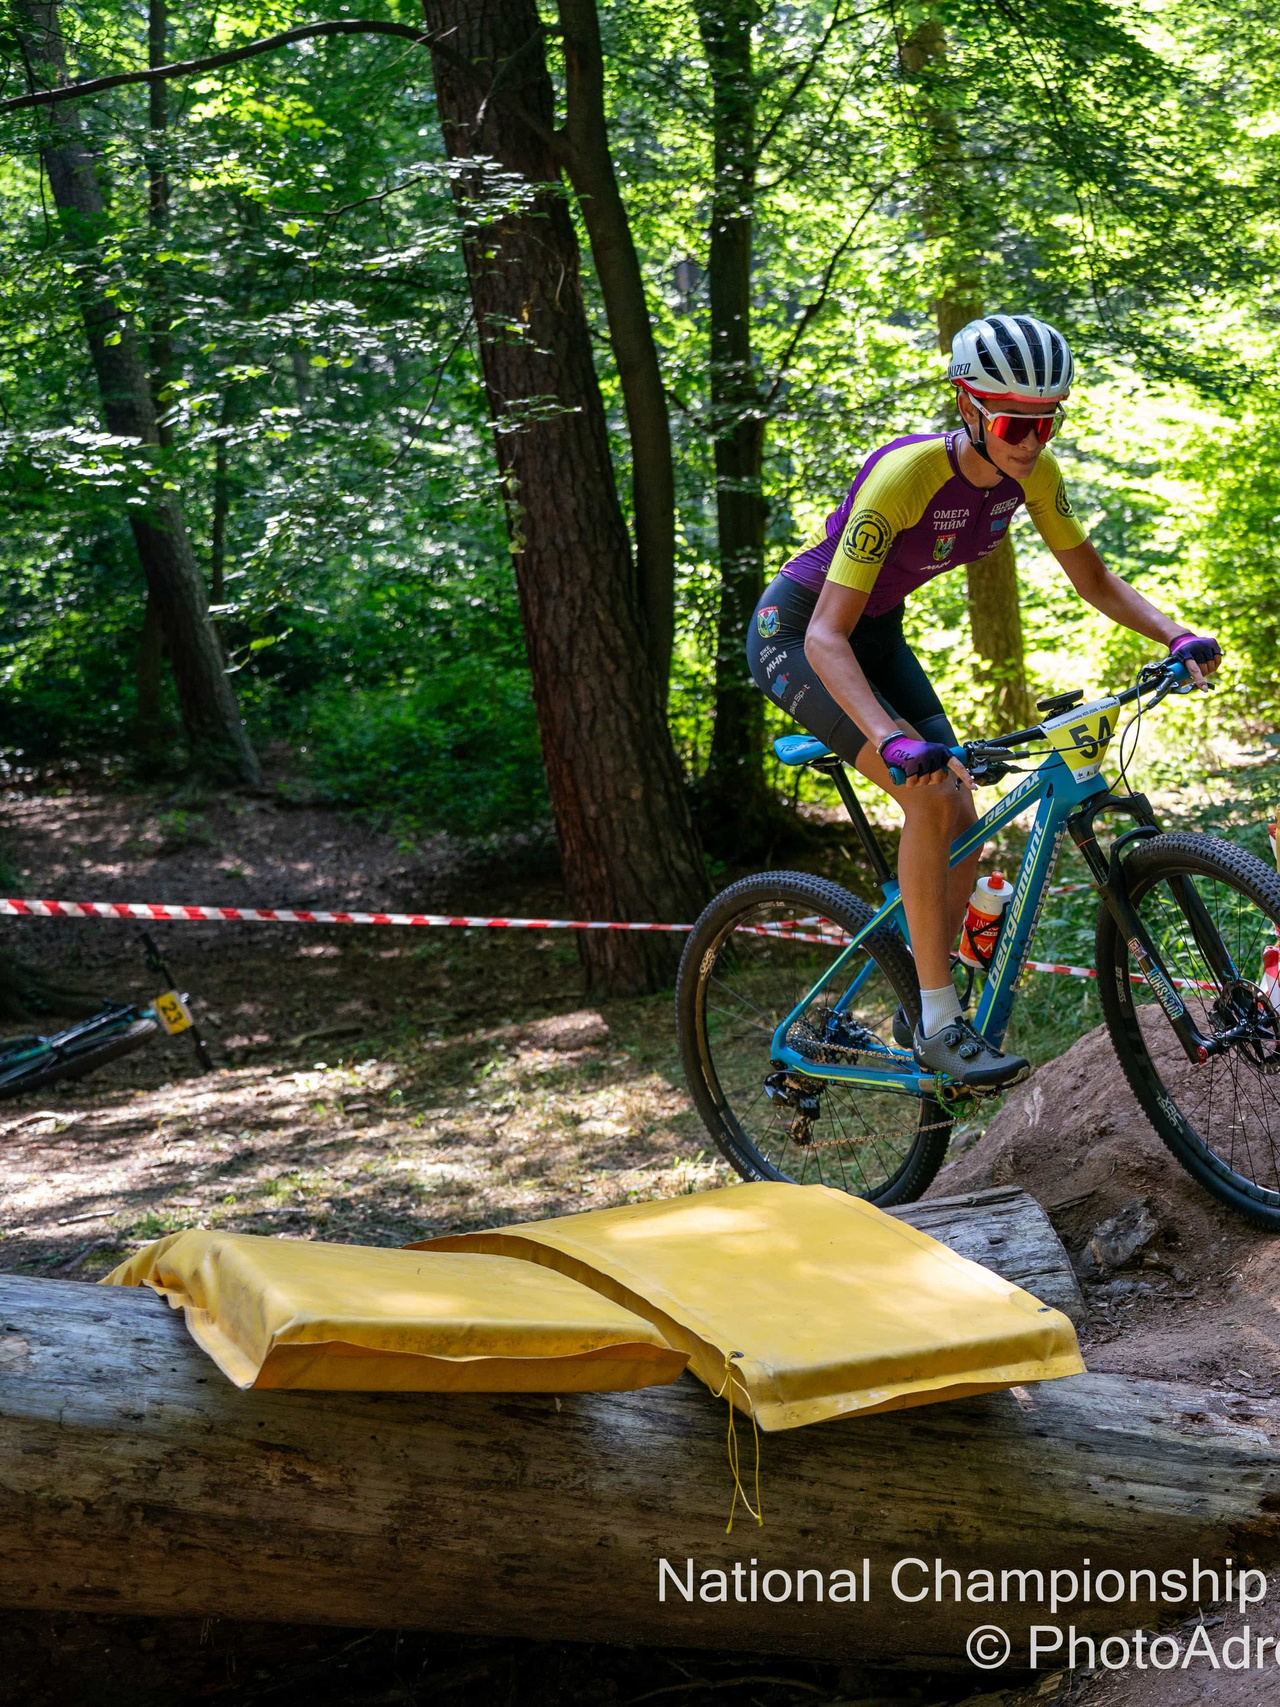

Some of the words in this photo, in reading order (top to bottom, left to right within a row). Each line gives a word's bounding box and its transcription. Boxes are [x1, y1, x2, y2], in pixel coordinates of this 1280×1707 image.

[933, 508, 970, 519] ОМЕГА
[933, 518, 967, 530] ТИЙМ
[1068, 715, 1111, 759] 54
[988, 820, 1043, 990] bergamont
[161, 1001, 183, 1024] 23
